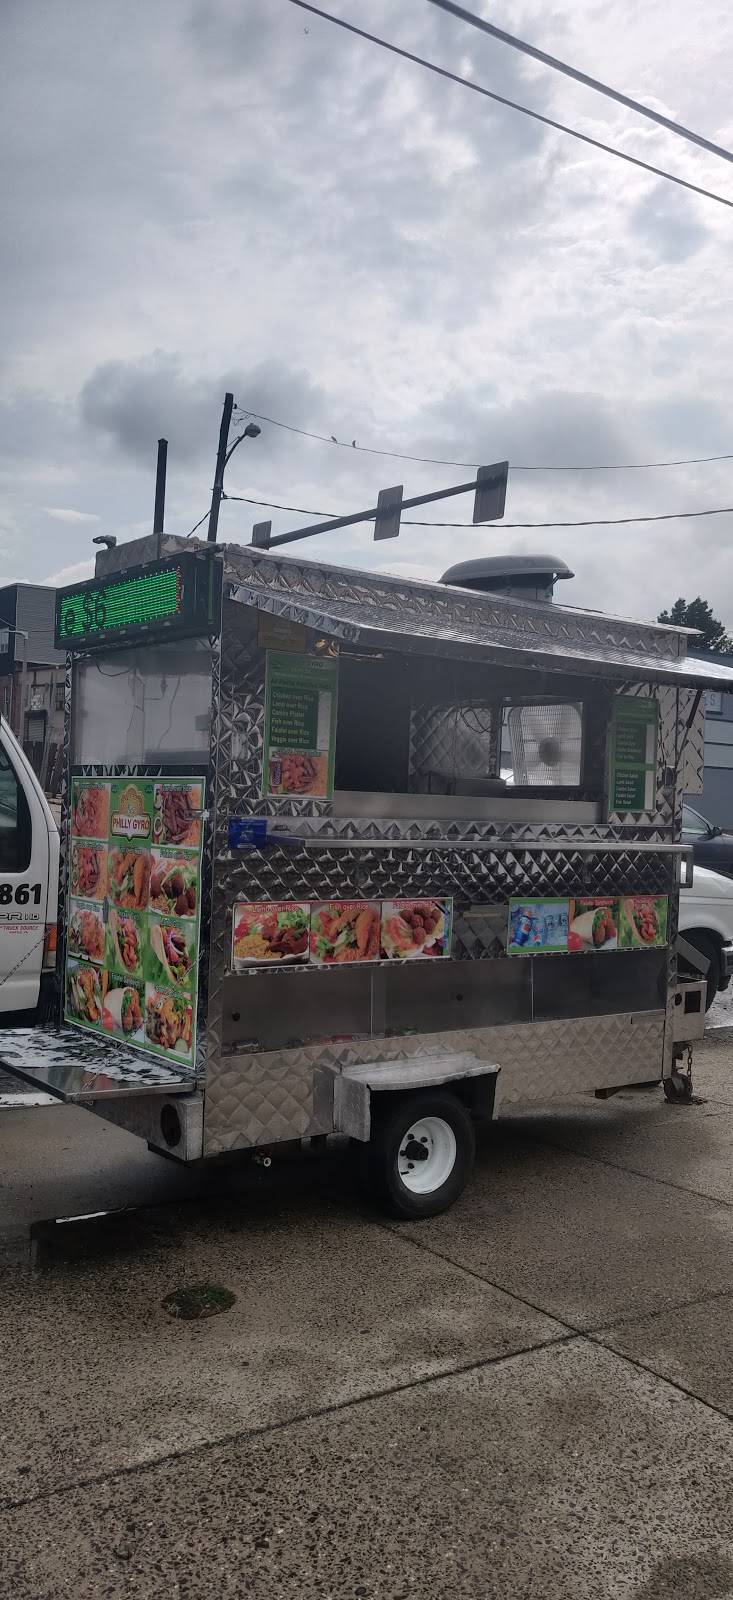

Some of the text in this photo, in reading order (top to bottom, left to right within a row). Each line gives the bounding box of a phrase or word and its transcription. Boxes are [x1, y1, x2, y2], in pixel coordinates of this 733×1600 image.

[112, 816, 150, 830] PHILLY GYRO
[0, 883, 42, 905] 861
